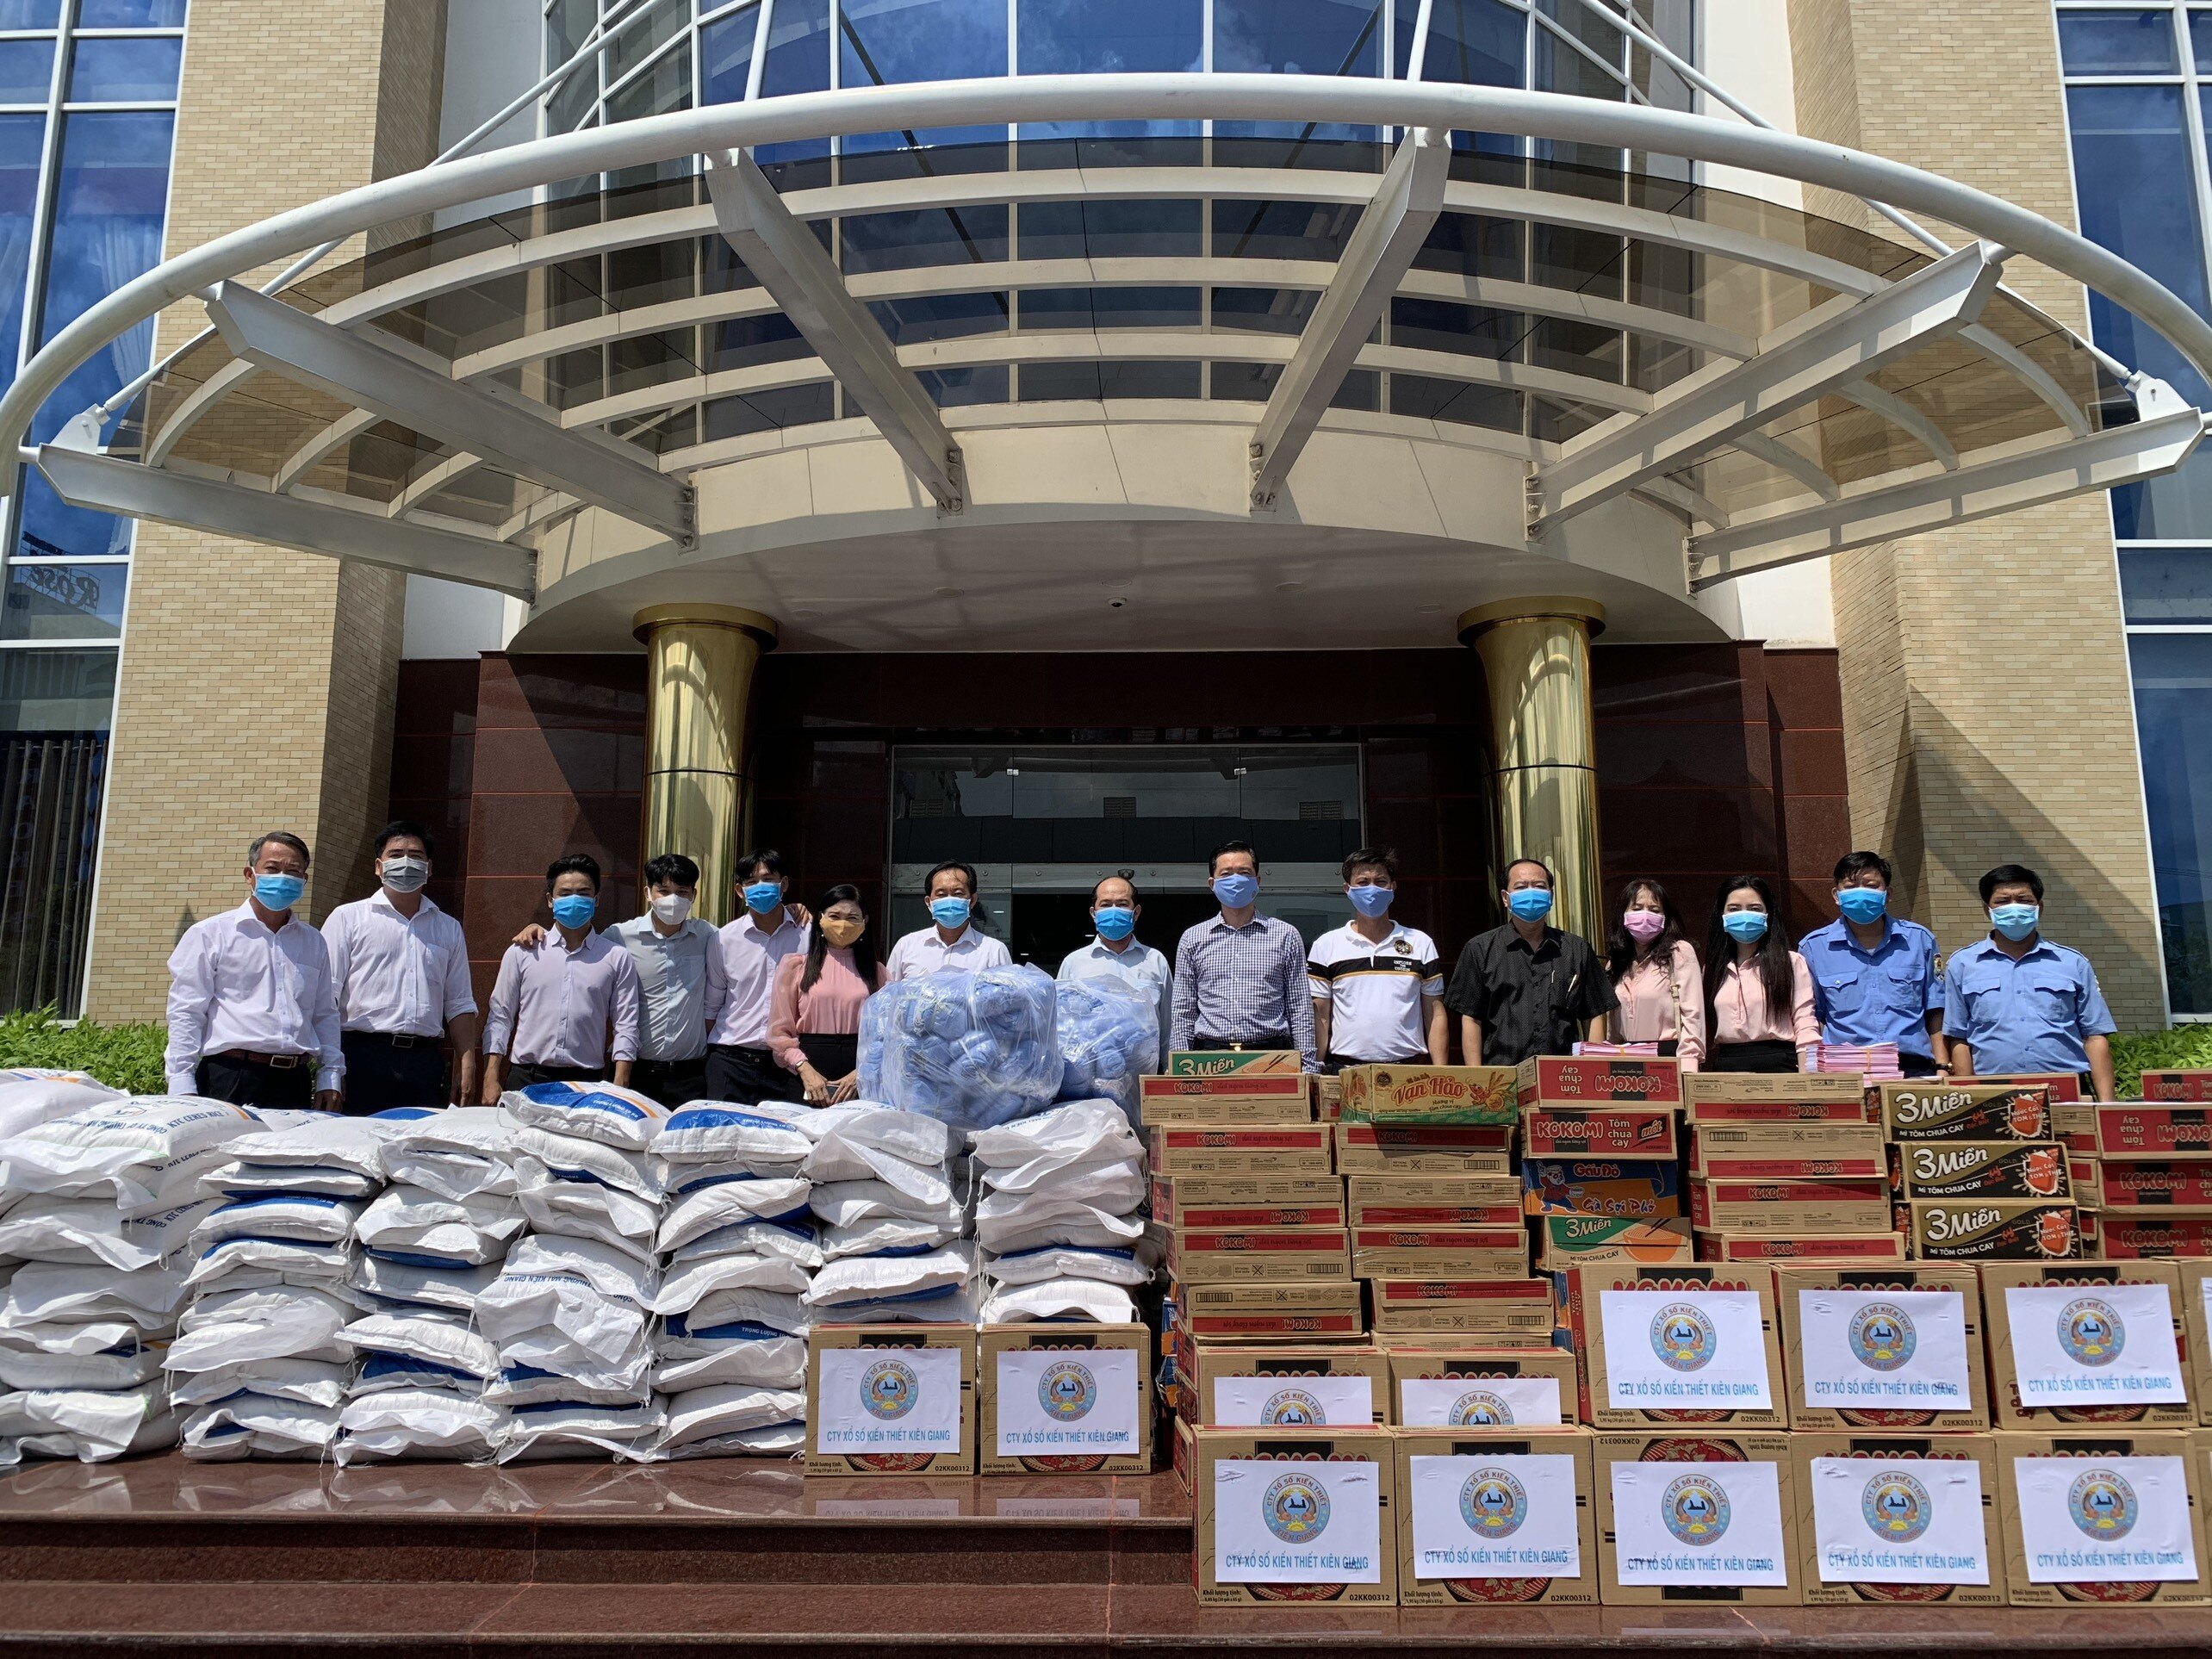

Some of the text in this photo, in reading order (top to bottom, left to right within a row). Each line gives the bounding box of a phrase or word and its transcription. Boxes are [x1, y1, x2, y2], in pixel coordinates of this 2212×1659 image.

[1179, 1059, 1195, 1075] 3
[1562, 1066, 1578, 1074] cay
[1174, 1082, 1213, 1093] KOKOMI
[1392, 1076, 1467, 1106] Vạn Hảo
[1561, 1085, 1582, 1095] Tôm
[1595, 1075, 1662, 1093] KOKOMI
[2153, 1083, 2195, 1099] KOKOMI
[1787, 1105, 1830, 1116] KOKOMI
[1895, 1091, 1973, 1123] 3 Miền
[167, 1118, 185, 1128] KTC
[183, 1112, 208, 1122] CERES
[1608, 1119, 1631, 1128] Tôm
[2122, 1115, 2140, 1124] cay
[1537, 1122, 1604, 1139] KOKOMI
[1607, 1129, 1632, 1138] chua
[1641, 1120, 1663, 1138] mới
[1910, 1128, 1925, 1137] TÔM
[1948, 1124, 1964, 1134] CAY
[2157, 1124, 2212, 1142] OKOMI
[1196, 1134, 1236, 1146] KOKOMI
[1612, 1139, 1629, 1149] cay
[2122, 1136, 2145, 1146] Tôm
[1800, 1162, 1843, 1173] KOKOMI
[1913, 1147, 1988, 1179] 3 Miền
[1928, 1185, 1943, 1194] TÔM
[1944, 1184, 1967, 1193] CHUA
[1967, 1181, 1981, 1190] CAY
[2120, 1172, 2187, 1190] KOKOMI
[1749, 1188, 1791, 1199] KOKOMI
[1582, 1197, 1656, 1215] Gà Sợi Phở
[165, 1210, 178, 1223] KTC
[1270, 1211, 1309, 1223] KOKOMI
[1448, 1209, 1489, 1221] KOKOMI
[1566, 1218, 1612, 1238] 3 Miền
[1925, 1208, 2001, 1240] 3 Miền
[1215, 1237, 1257, 1249] KOKOMI
[1389, 1233, 1431, 1246] KOKOMI
[2122, 1230, 2189, 1248] KOKOMI
[1606, 1250, 1619, 1259] CAY
[1762, 1243, 1805, 1255] KOKOMI
[1940, 1247, 1955, 1256] TÔM
[1956, 1247, 1979, 1256] CHUA
[1979, 1242, 1994, 1252] CAY
[1417, 1285, 1458, 1297] KOKOMI
[1282, 1318, 1322, 1330] KOKOMI
[1619, 1376, 1758, 1395] CTY XỔ SỐ KIẾN THIẾT KIÊN GIANG
[1815, 1376, 1958, 1395] CTY XỔ SỐ KIẾN THIẾT KIÊN GIANG
[827, 1426, 950, 1442] CTY XỔ SỐ KIẾN THIẾT KIÊN GIANG
[1006, 1427, 1129, 1443] CTY XỔ SỐ KIẾN THIẾT KIÊN GIANG
[1226, 1550, 1368, 1569] CTY XỔ SỐ KIẾN THIẾT KIÊN GIANG
[1425, 1544, 1568, 1563] CTY XỔ SỐ KIẾN THIẾT KIÊN GIANG
[1828, 1547, 1976, 1569] CTY XỔ SỐ KIẾN THIẾT KIÊN GIANG
[1628, 1552, 1774, 1570] CTY XỔ SỐ KIẾN THIẾT KIÊN GIANG
